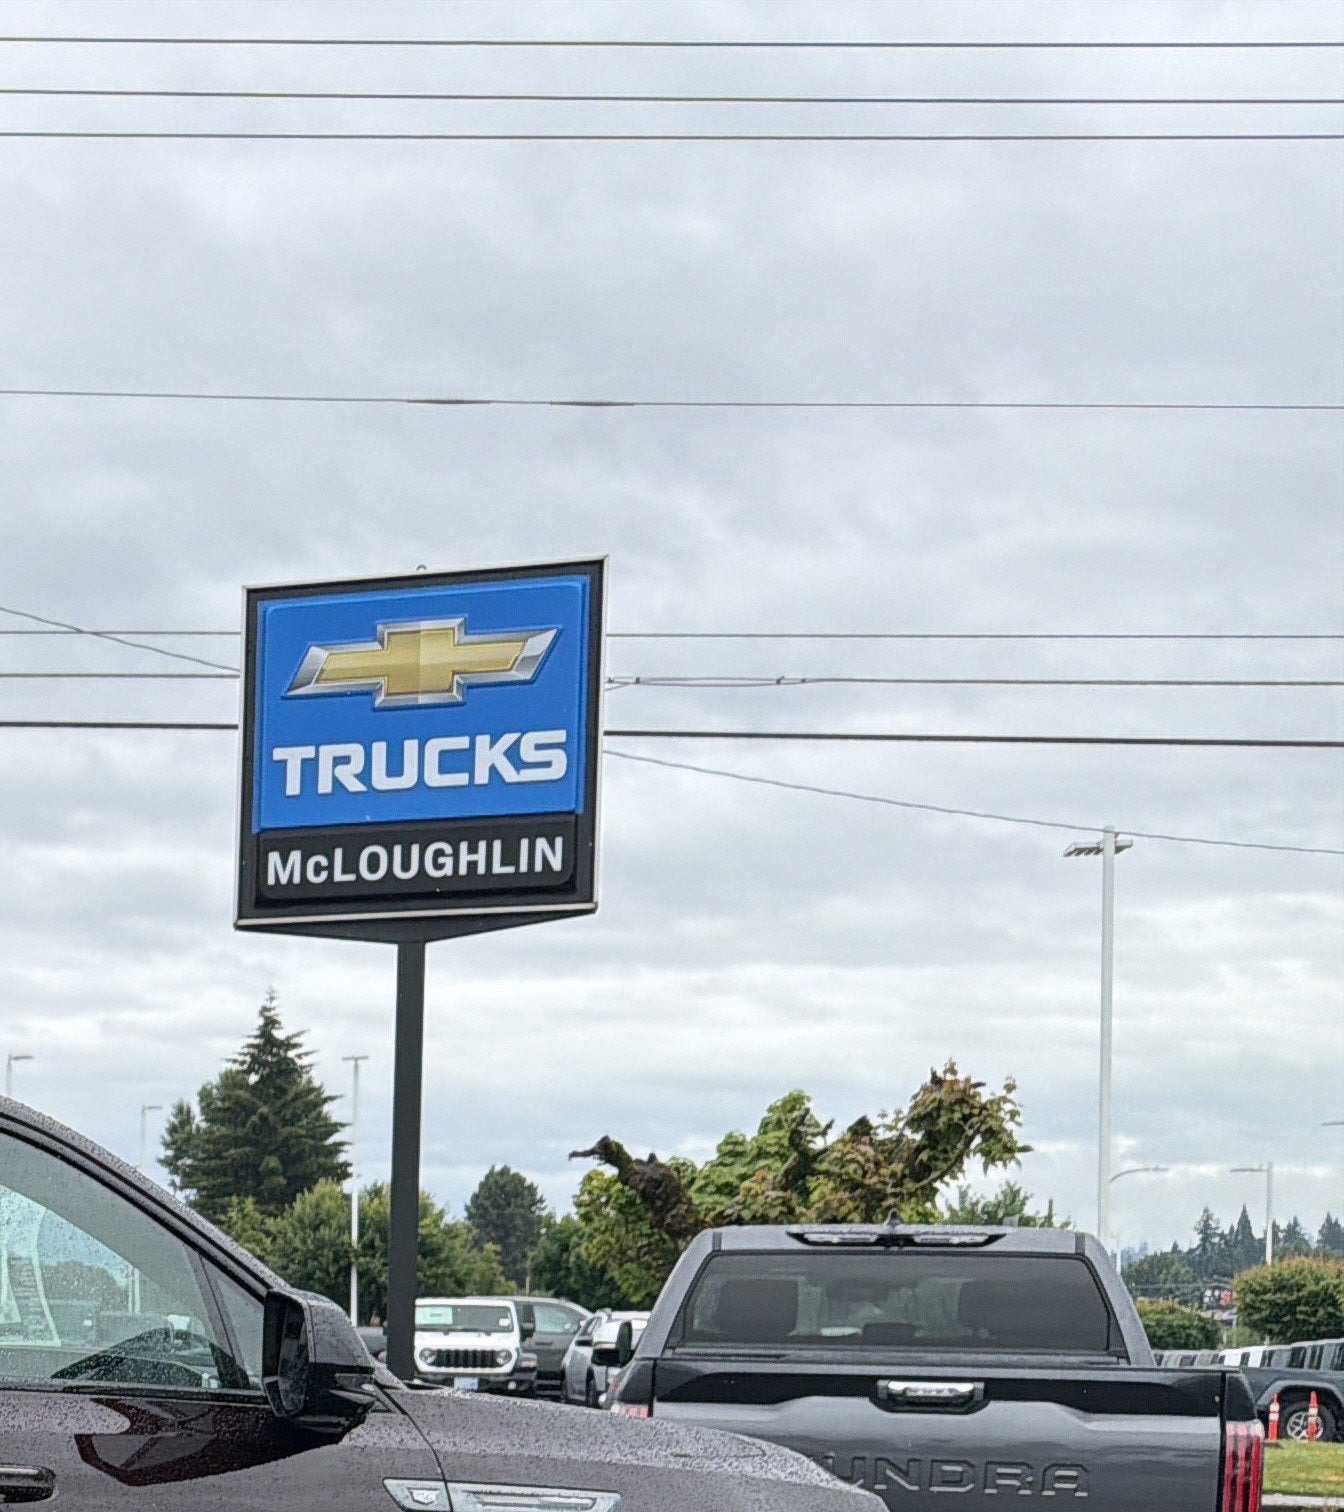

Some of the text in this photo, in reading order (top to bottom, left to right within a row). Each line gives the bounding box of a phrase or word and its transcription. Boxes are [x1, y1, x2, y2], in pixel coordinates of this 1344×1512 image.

[272, 729, 568, 797] TRUCKS
[265, 836, 565, 886] McLOUGHLIN
[821, 1452, 1090, 1498] UNDRA
